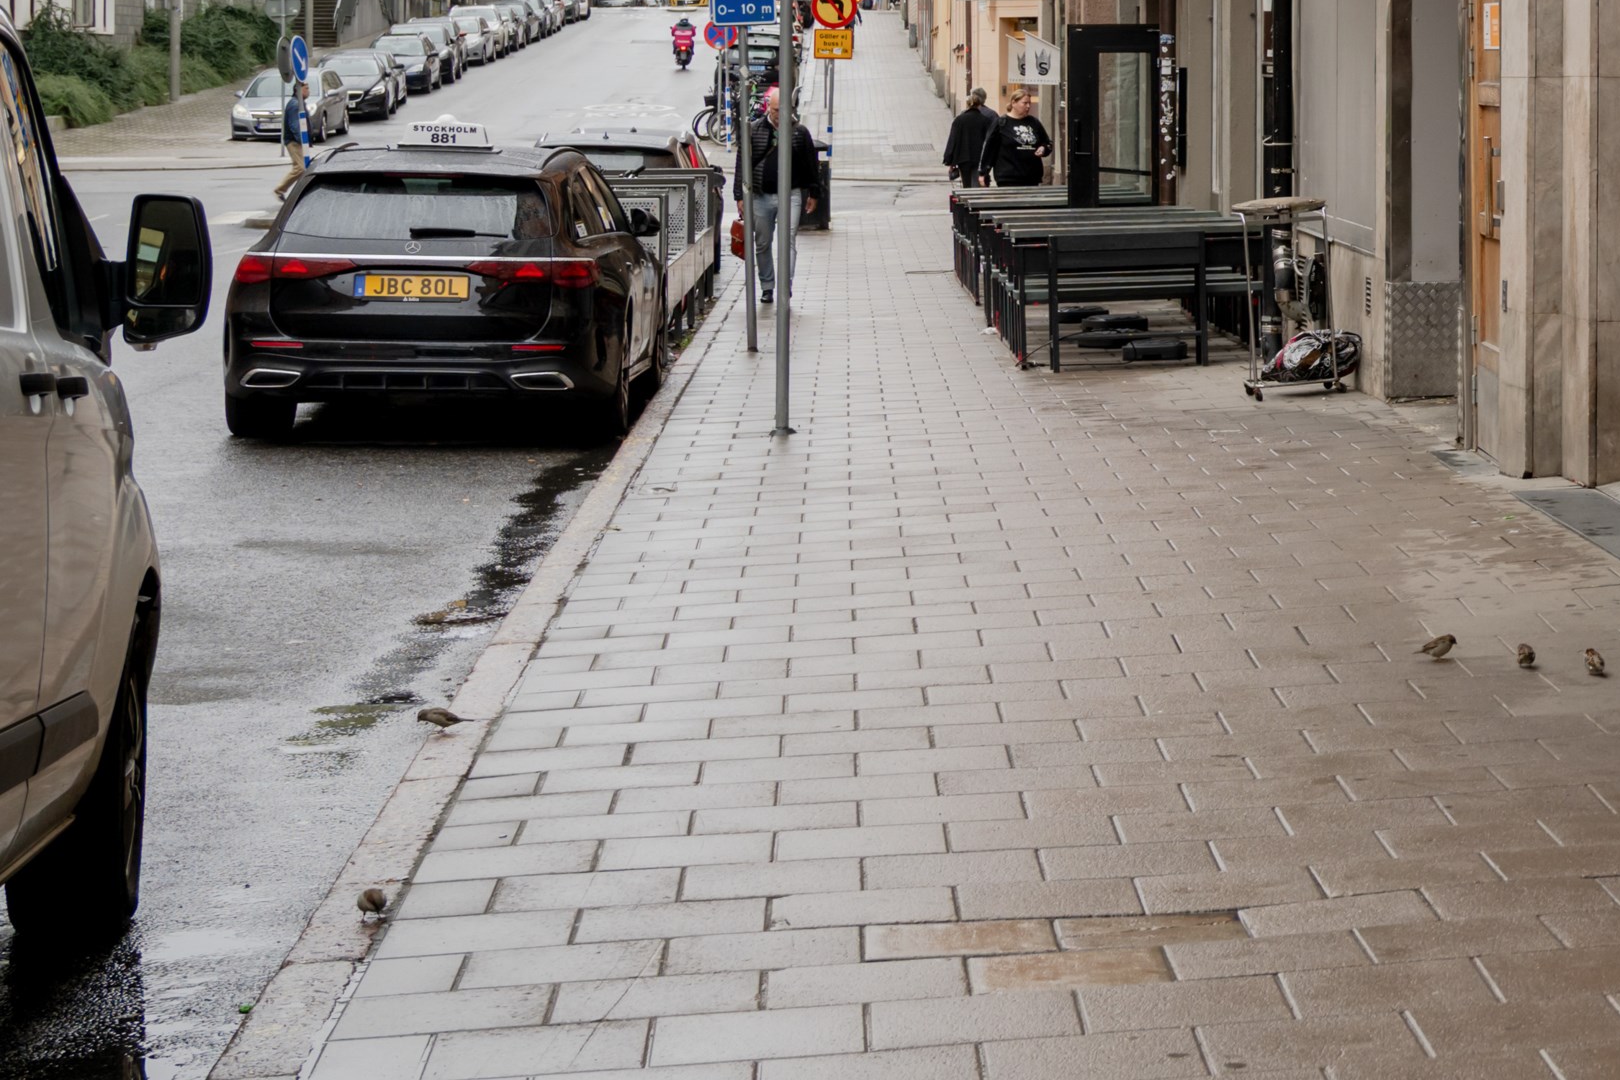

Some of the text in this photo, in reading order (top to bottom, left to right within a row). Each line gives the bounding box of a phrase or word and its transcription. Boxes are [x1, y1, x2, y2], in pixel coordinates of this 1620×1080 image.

[761, 4, 772, 14] m
[412, 125, 478, 134] STOCKHOLM
[430, 133, 457, 144] 881
[373, 278, 413, 295] JBC
[419, 278, 459, 296] 80L
